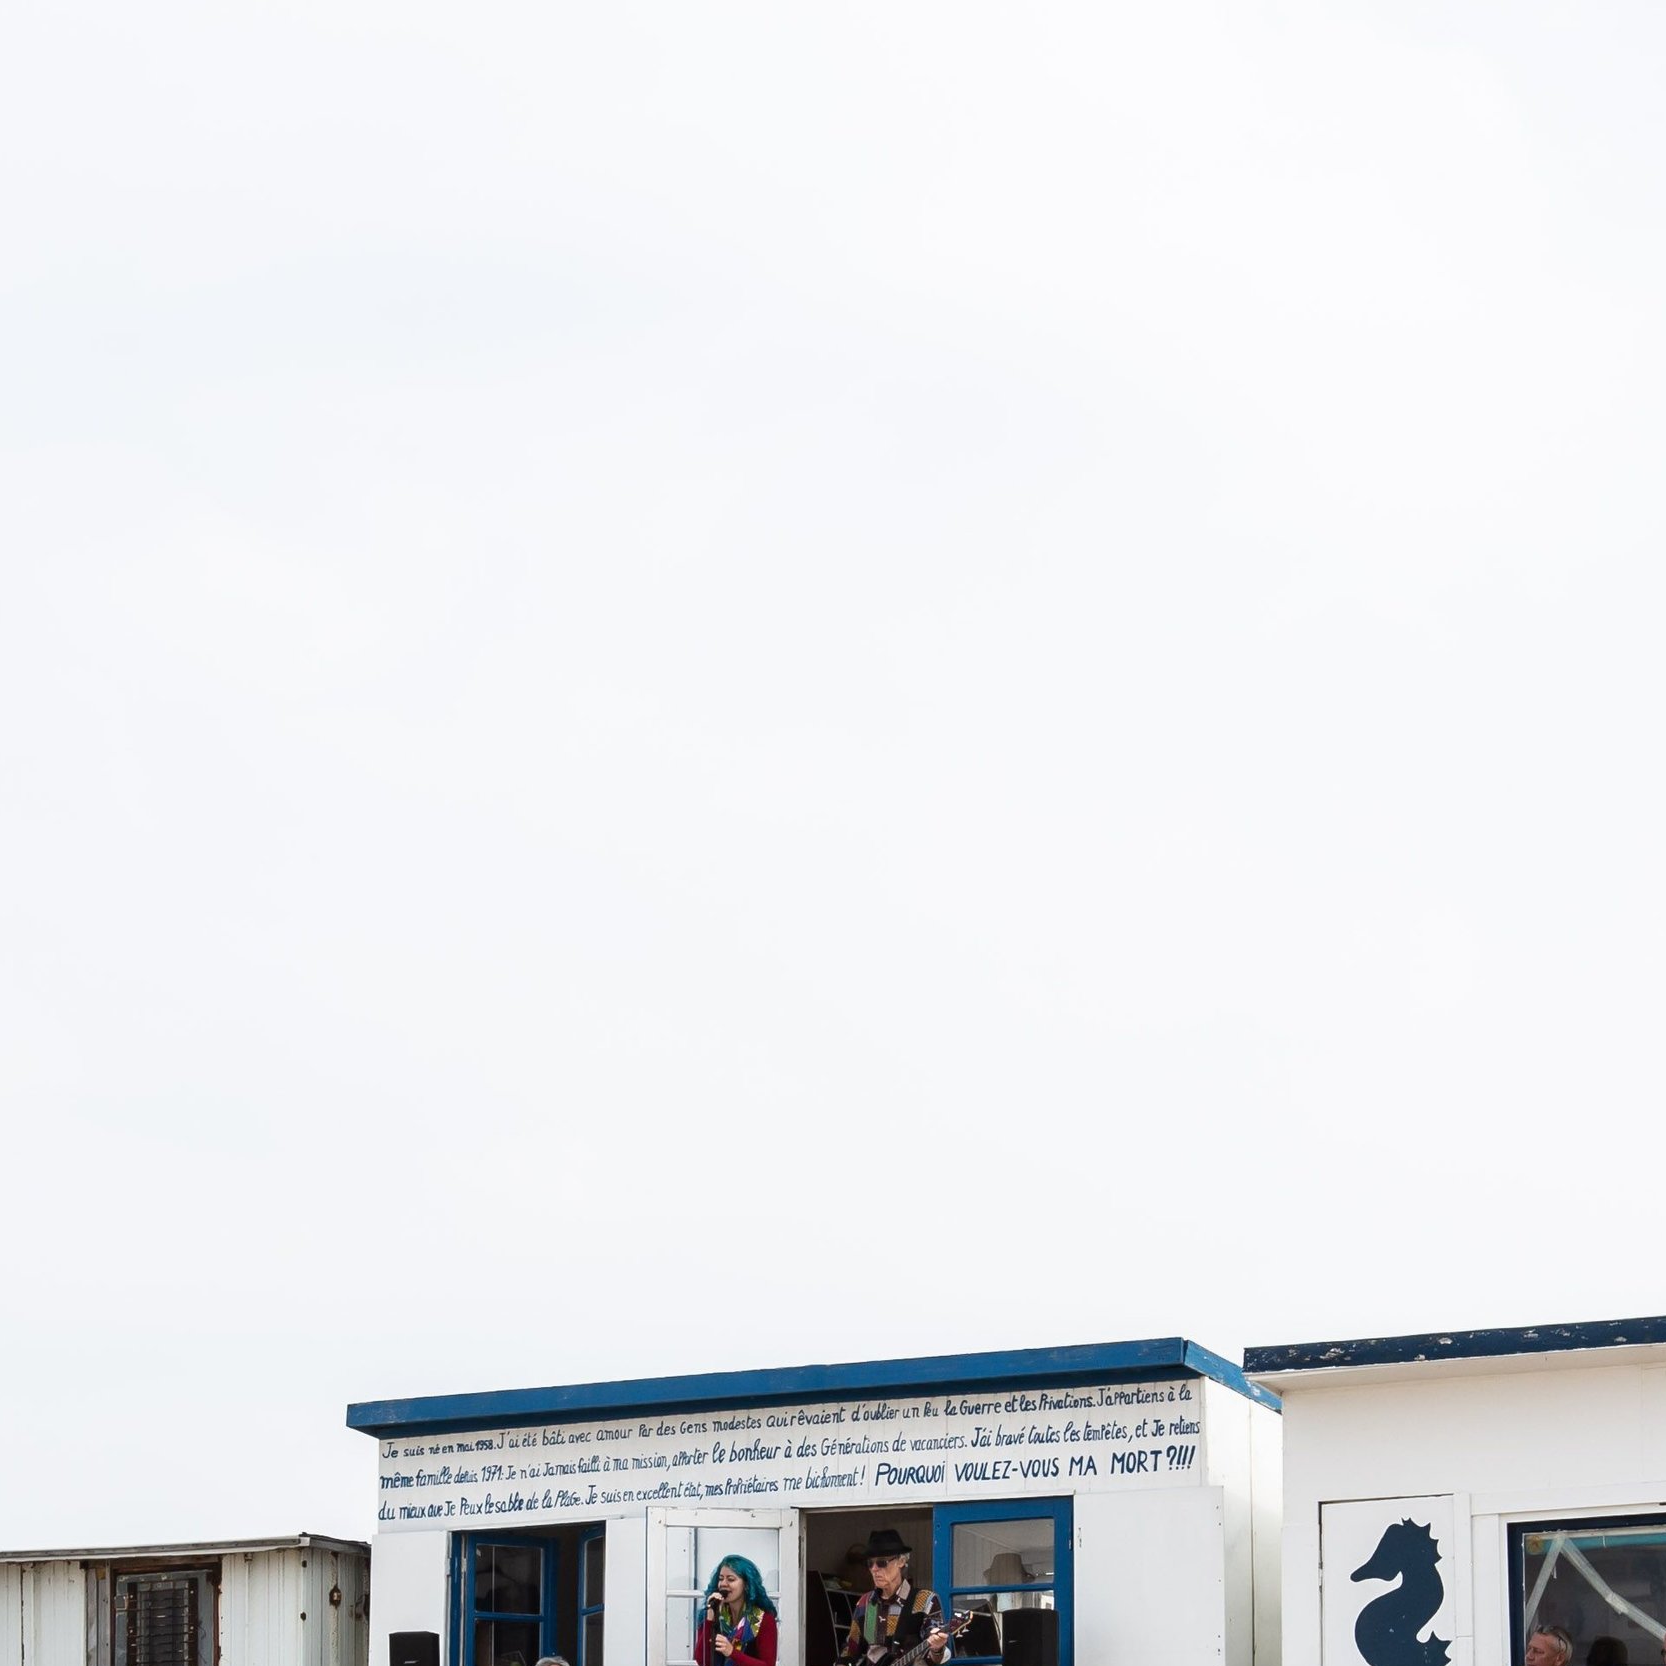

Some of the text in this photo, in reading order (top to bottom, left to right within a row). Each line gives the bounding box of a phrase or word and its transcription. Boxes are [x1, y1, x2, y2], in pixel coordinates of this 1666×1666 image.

[380, 1472, 415, 1489] même
[416, 1466, 452, 1487] famille
[506, 1465, 517, 1480] Je
[521, 1464, 541, 1479] n'ai
[578, 1455, 601, 1473] failli
[604, 1456, 611, 1472] à
[613, 1458, 628, 1471] ma
[632, 1452, 671, 1471] mission,
[712, 1442, 726, 1464] le
[729, 1439, 781, 1462] bonheur
[784, 1439, 792, 1458] à
[797, 1436, 818, 1458] des
[892, 1431, 907, 1452] de
[911, 1433, 968, 1451] vacanciers.
[996, 1424, 1026, 1447] bravé
[1064, 1421, 1082, 1442] les
[1135, 1418, 1149, 1438] et
[1151, 1419, 1166, 1437] Je
[1169, 1415, 1201, 1436] retiens
[382, 1442, 399, 1458] Je
[403, 1446, 425, 1457] suis
[442, 1445, 455, 1454] en
[457, 1442, 475, 1452] mai
[522, 1432, 537, 1447] été
[543, 1429, 566, 1446] bâti
[569, 1432, 592, 1443] avec
[597, 1429, 634, 1441] amour
[657, 1421, 677, 1436] des
[713, 1415, 762, 1432] modestes
[791, 1407, 847, 1426] rêvaient
[851, 1402, 900, 1422] d'oublier
[903, 1407, 920, 1418] un
[944, 1399, 959, 1416] la
[960, 1400, 1002, 1415] Guerre
[1005, 1395, 1018, 1413] et
[1019, 1394, 1038, 1412] les
[1168, 1386, 1176, 1402] à
[1179, 1384, 1193, 1401] la
[379, 1500, 396, 1520] du
[444, 1501, 456, 1516] Je
[485, 1493, 496, 1514] le
[495, 1491, 524, 1513] sable
[526, 1492, 539, 1511] de
[541, 1489, 554, 1509] la
[585, 1485, 599, 1505] Je
[601, 1489, 622, 1504] suis
[623, 1491, 634, 1502] en
[637, 1481, 684, 1500] excellent
[684, 1482, 704, 1500] état,
[705, 1484, 724, 1496] mes
[783, 1477, 801, 1491] me
[875, 1462, 946, 1486] POURQUOI
[955, 1457, 1060, 1482] VOULEZ-VOUS
[1068, 1455, 1098, 1476] MA
